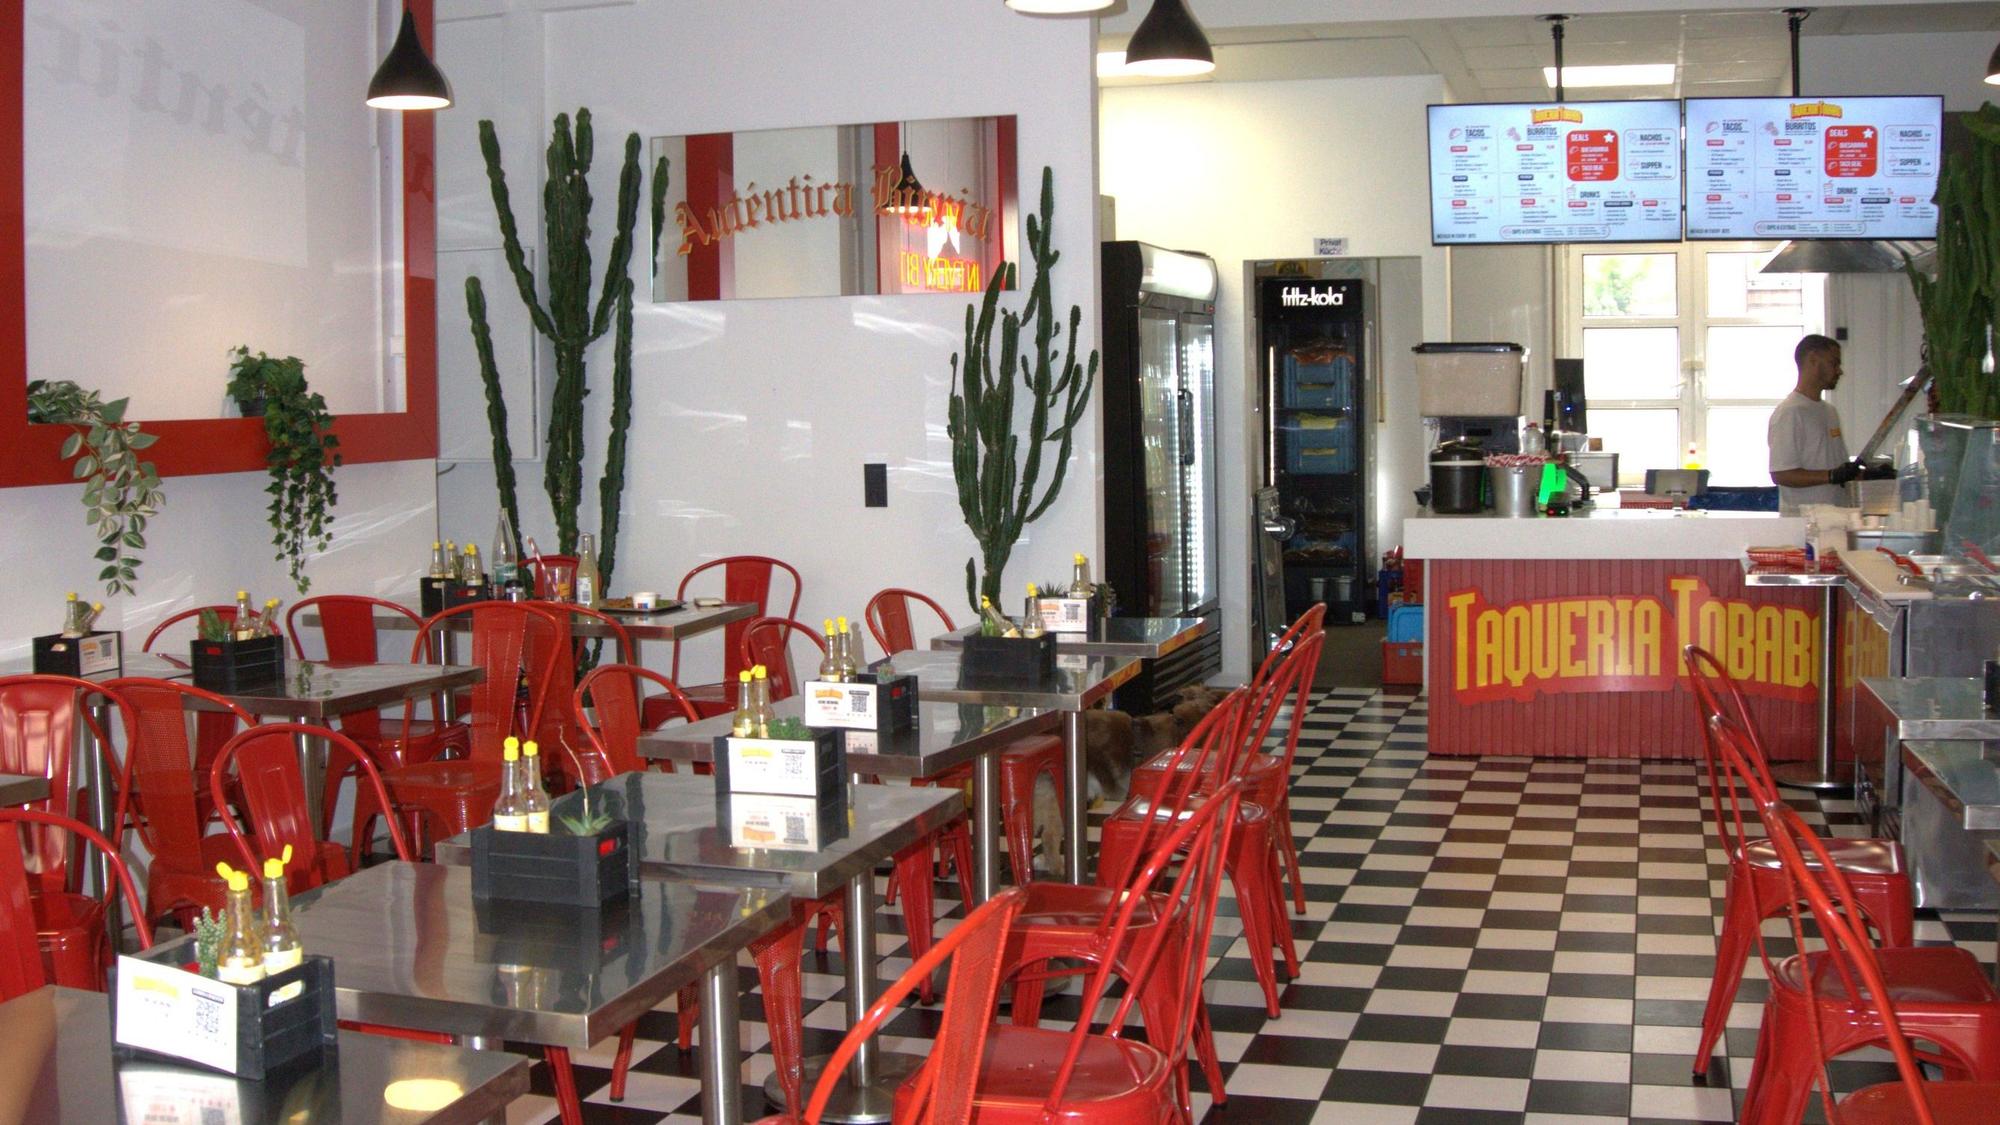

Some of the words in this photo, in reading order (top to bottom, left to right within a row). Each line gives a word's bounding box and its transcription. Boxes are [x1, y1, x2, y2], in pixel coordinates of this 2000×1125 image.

[1722, 122, 1743, 131] TACOS
[1785, 122, 1816, 131] BURRITOS
[1465, 128, 1485, 137] TACOS
[1526, 127, 1558, 136] BURRITOS
[1829, 129, 1848, 137] DEALS
[1899, 130, 1923, 138] NACHOS
[1570, 133, 1589, 142] DEALS
[1639, 133, 1663, 142] NACHOS
[1579, 190, 1601, 199] DRINKS
[674, 174, 857, 256] Auténtica
[1449, 592, 1662, 691] TAQUERIA
[1671, 579, 1821, 689] TOBAB
